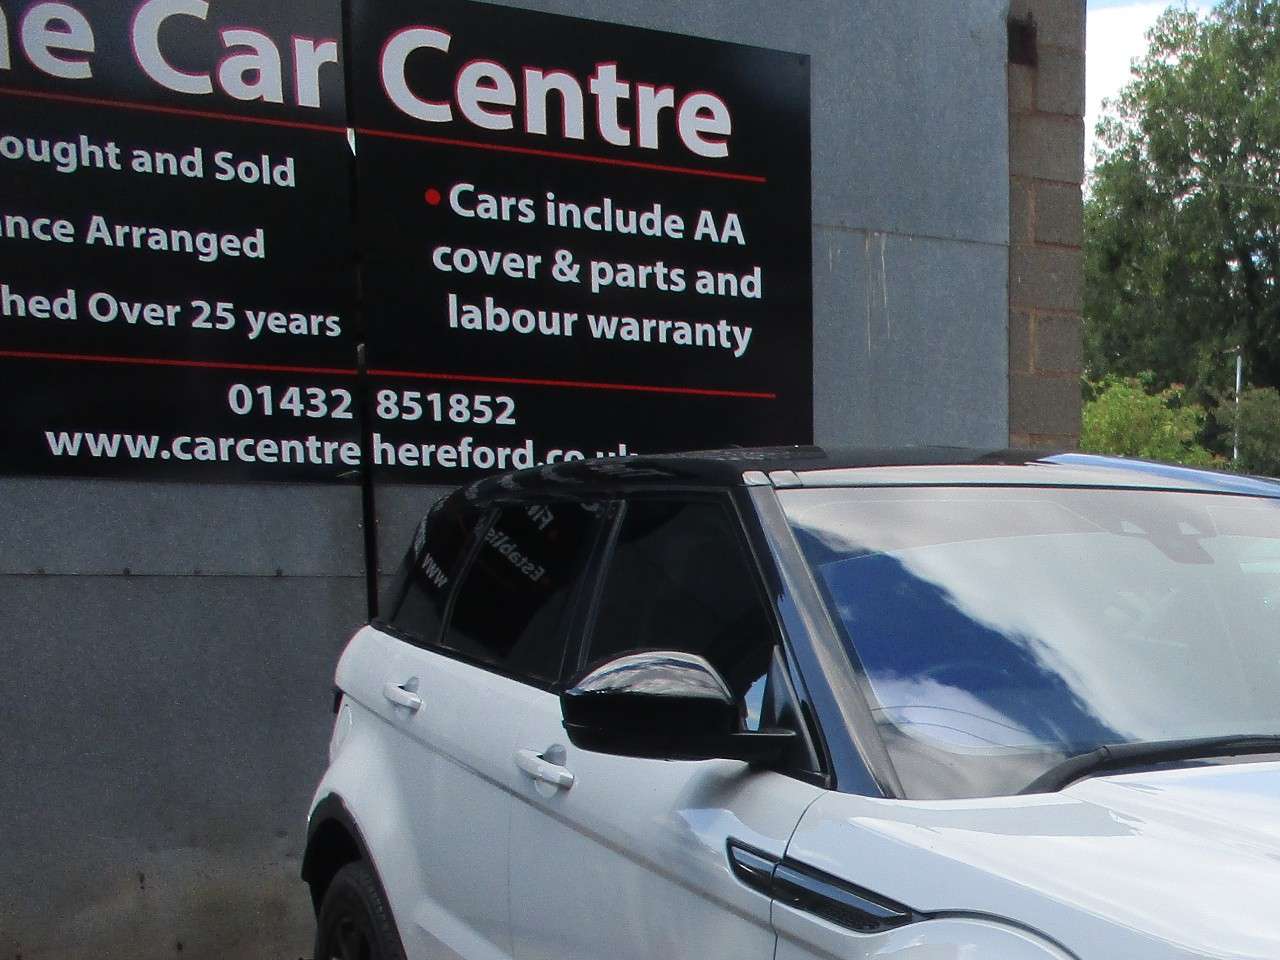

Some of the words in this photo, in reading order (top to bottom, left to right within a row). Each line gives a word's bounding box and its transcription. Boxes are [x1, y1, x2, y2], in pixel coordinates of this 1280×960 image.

[133, 0, 337, 107] Car
[382, 29, 731, 157] Centre
[132, 147, 203, 177] and
[215, 152, 295, 187] Sold
[450, 184, 535, 223] Cars
[547, 192, 684, 238] include
[694, 210, 745, 244] AA
[0, 216, 74, 242] nce
[87, 216, 264, 262] Arranged
[433, 247, 541, 278] cover
[552, 250, 580, 283] &
[591, 261, 686, 293] parts
[696, 267, 761, 298] and
[89, 293, 180, 326] Over
[191, 301, 235, 329] 25
[245, 311, 341, 339] years
[449, 294, 577, 336] labour
[587, 315, 752, 357] warranty
[229, 384, 352, 418] 01432
[377, 390, 515, 424] 851852
